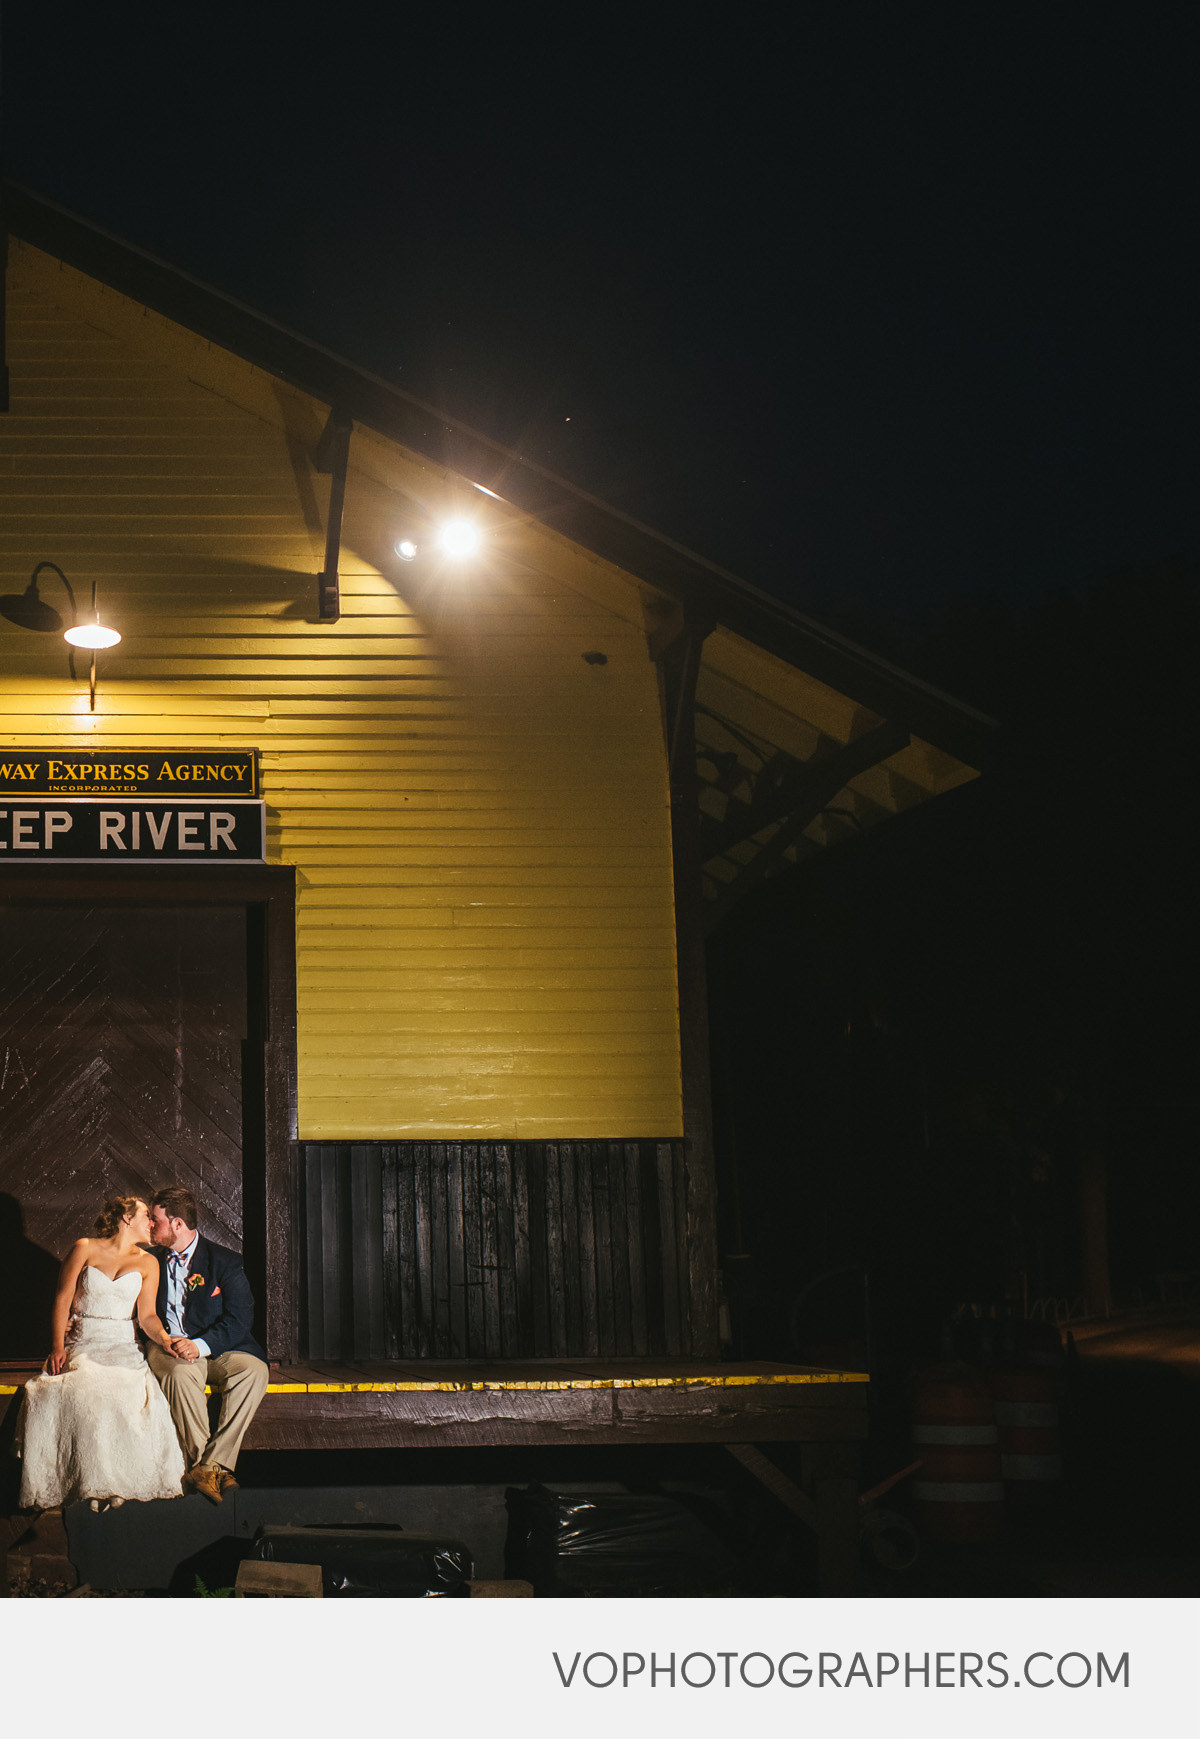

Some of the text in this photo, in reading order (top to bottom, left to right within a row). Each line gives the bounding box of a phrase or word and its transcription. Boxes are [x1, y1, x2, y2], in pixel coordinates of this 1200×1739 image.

[46, 760, 150, 781] EXPRESS
[156, 760, 249, 781] AGENCY
[99, 811, 238, 851] RIVER
